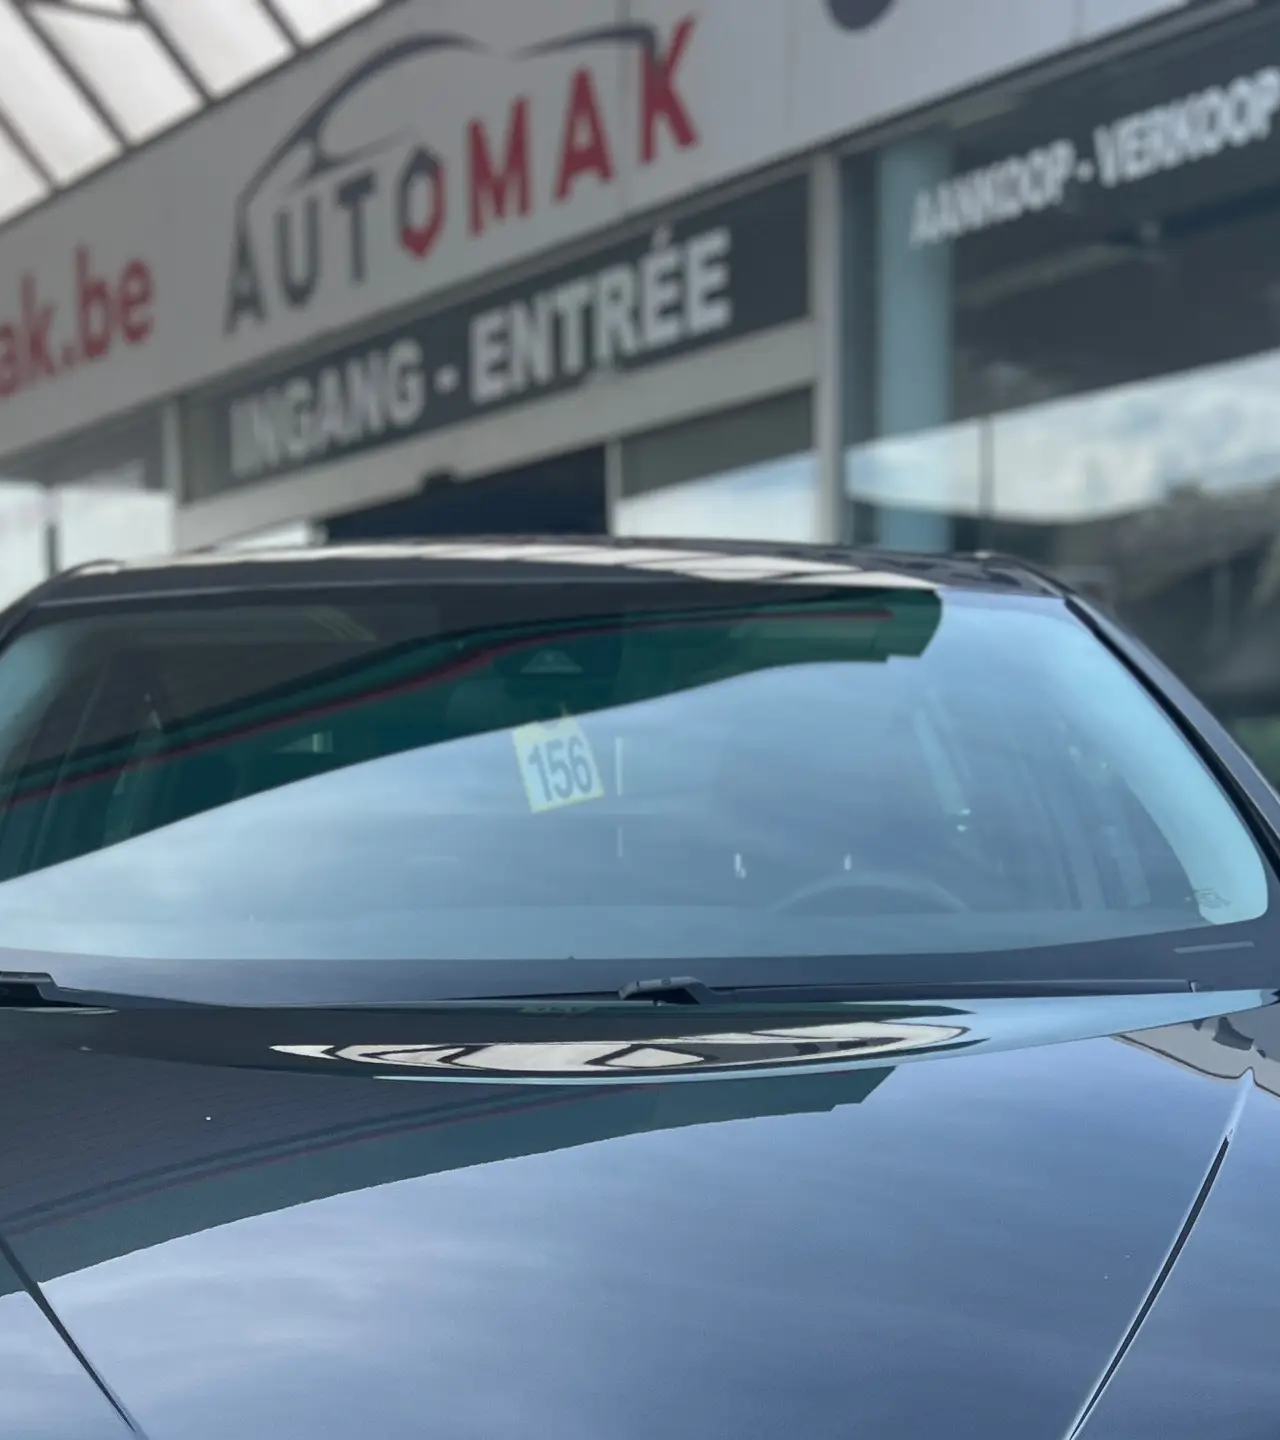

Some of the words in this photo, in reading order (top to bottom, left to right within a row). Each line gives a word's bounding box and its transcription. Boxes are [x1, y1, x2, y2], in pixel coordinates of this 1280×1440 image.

[223, 10, 700, 334] AUTOMAK
[910, 138, 1076, 246] AANKOOP
[229, 335, 424, 480] INGANG
[469, 222, 733, 404] ENTRÉE
[527, 735, 593, 802] 156
